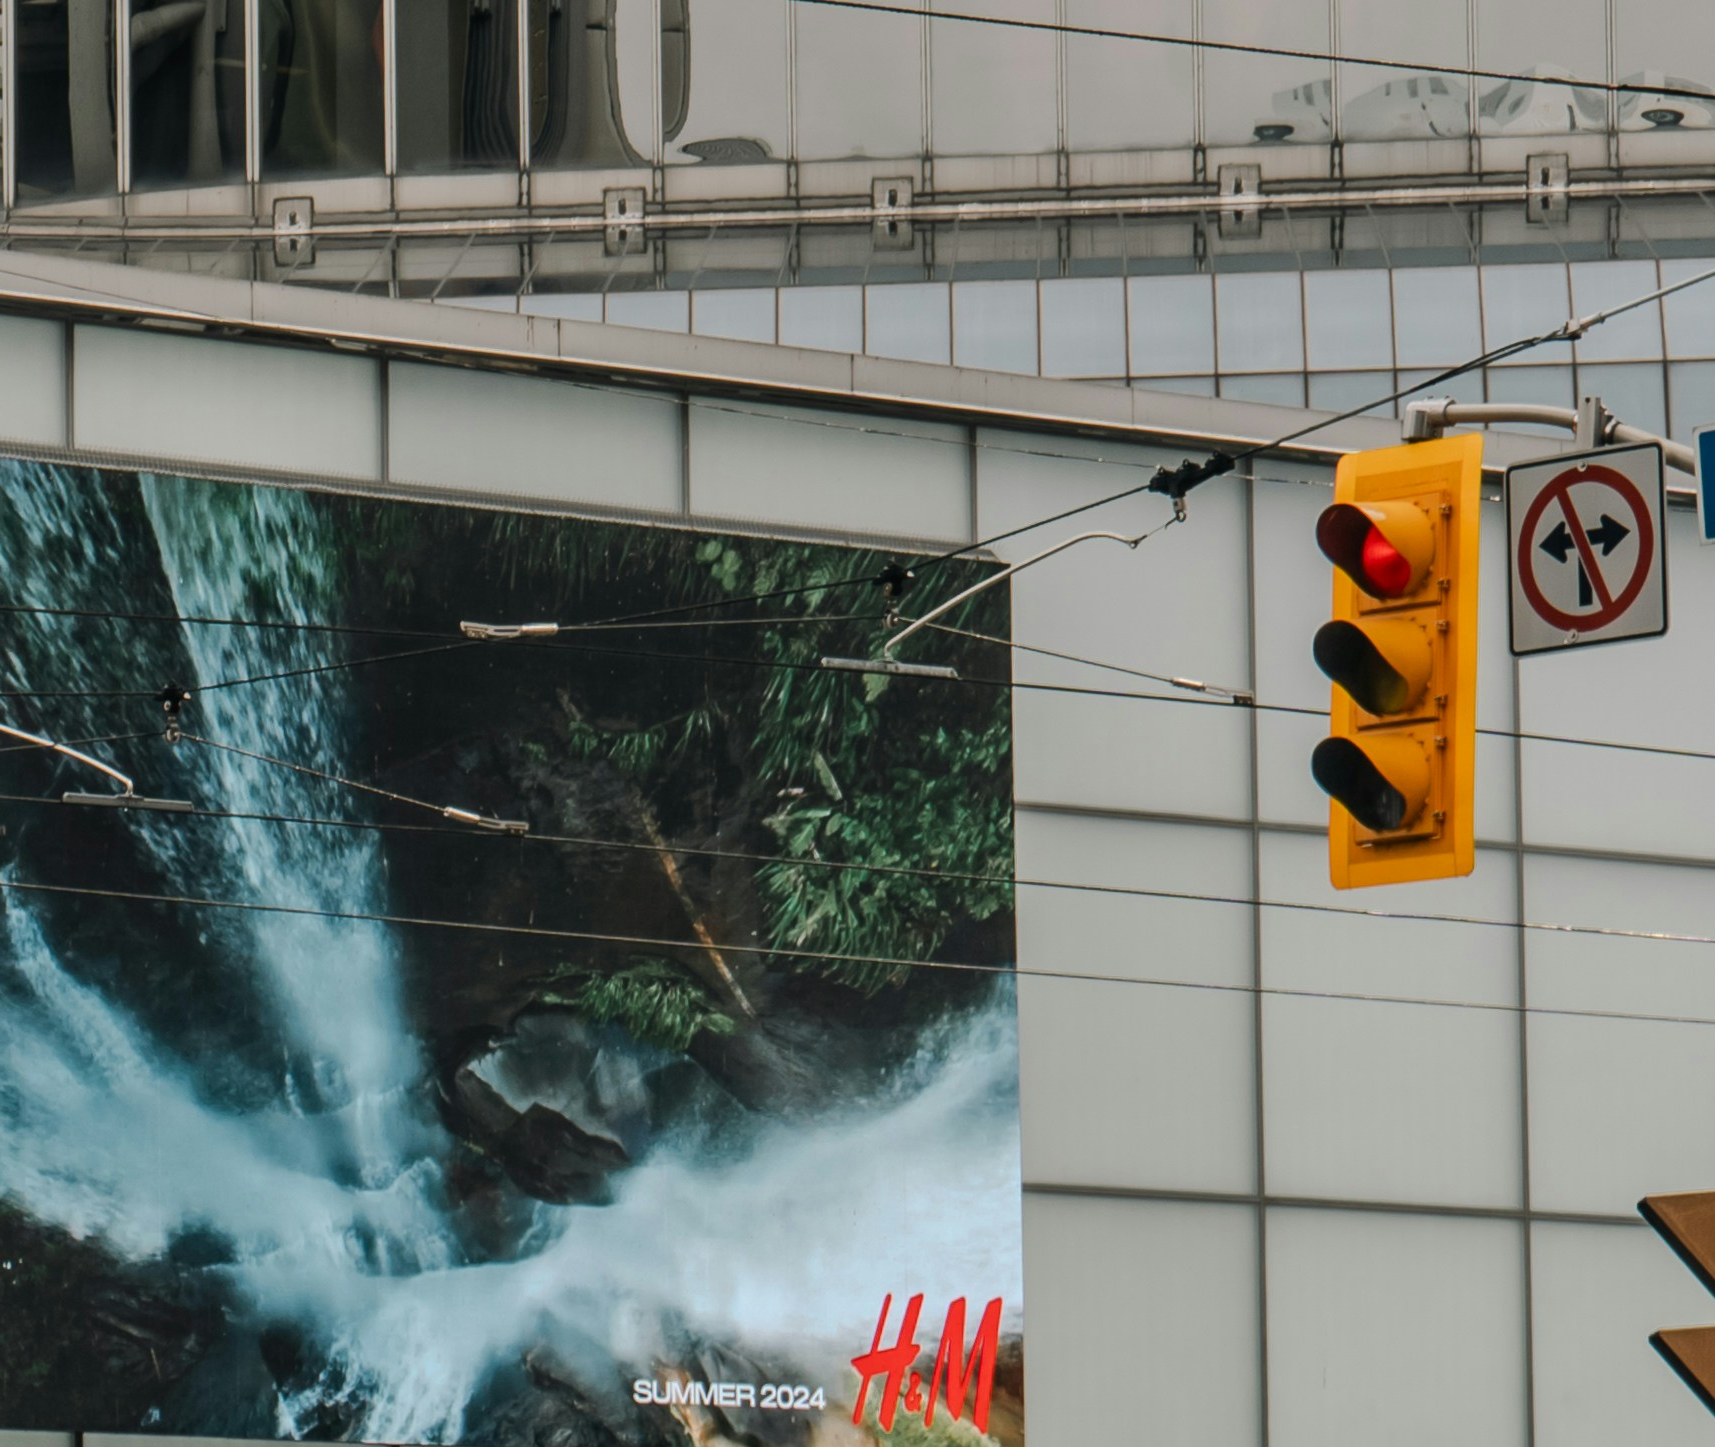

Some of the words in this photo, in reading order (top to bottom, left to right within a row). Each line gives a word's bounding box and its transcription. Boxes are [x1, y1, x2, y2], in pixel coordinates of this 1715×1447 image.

[633, 1378, 756, 1408] SUMMER
[760, 1383, 826, 1411] 2024
[850, 1292, 1003, 1434] H&M
